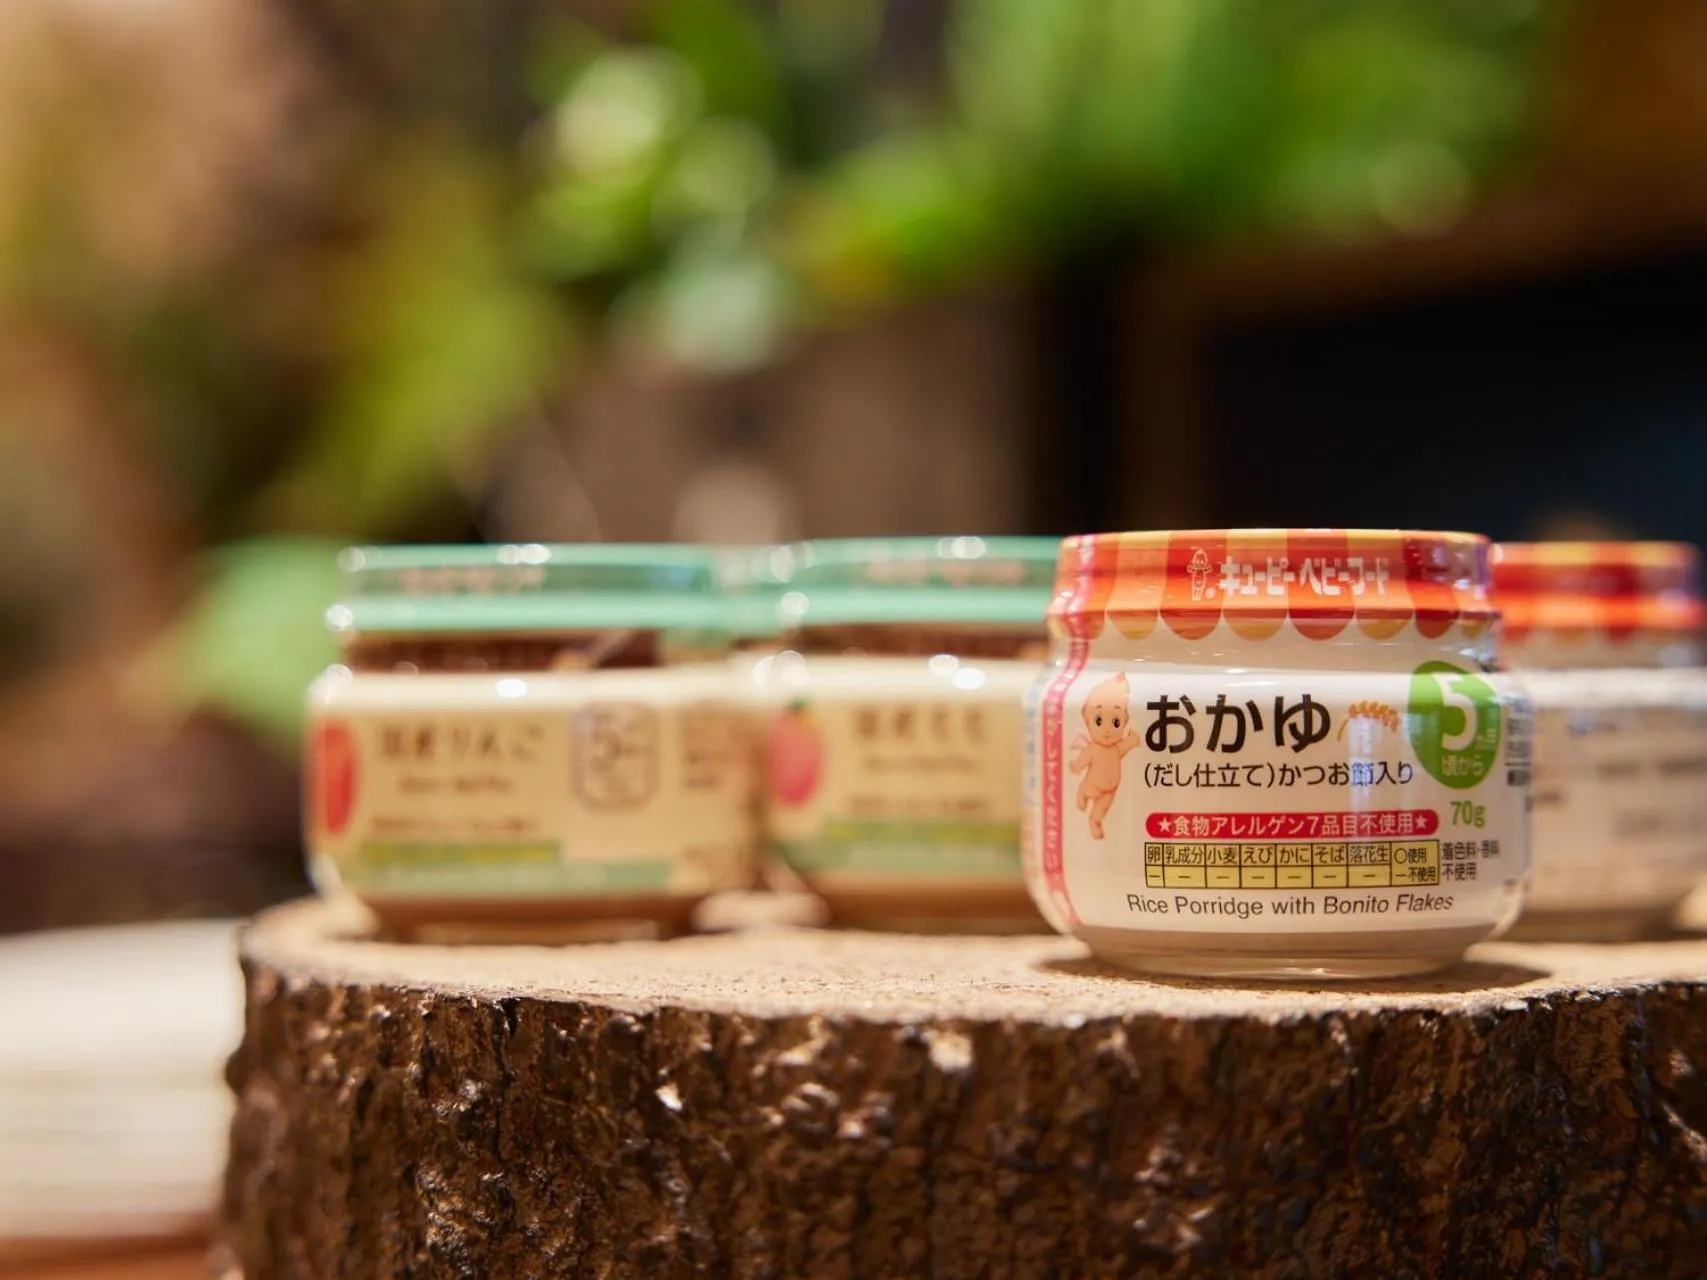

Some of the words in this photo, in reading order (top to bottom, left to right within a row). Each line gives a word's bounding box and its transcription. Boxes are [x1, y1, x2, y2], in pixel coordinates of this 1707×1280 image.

[1219, 556, 1296, 596] キューピー
[1299, 557, 1390, 596] ベビーフード
[1145, 693, 1331, 754] おかゆ
[1450, 800, 1487, 829] 70g
[1147, 846, 1161, 864] 卵
[1166, 846, 1204, 864] 乳成分
[1207, 846, 1238, 864] 小麦
[1243, 846, 1273, 864] えび
[1279, 846, 1310, 864] かに
[1315, 845, 1345, 864] そば
[1350, 845, 1389, 865] 落花生
[1127, 893, 1169, 914] Rice
[1174, 896, 1264, 919] Porridge
[1271, 896, 1315, 915] with
[1323, 895, 1390, 915] Bonito
[1396, 893, 1454, 913] Flakes
